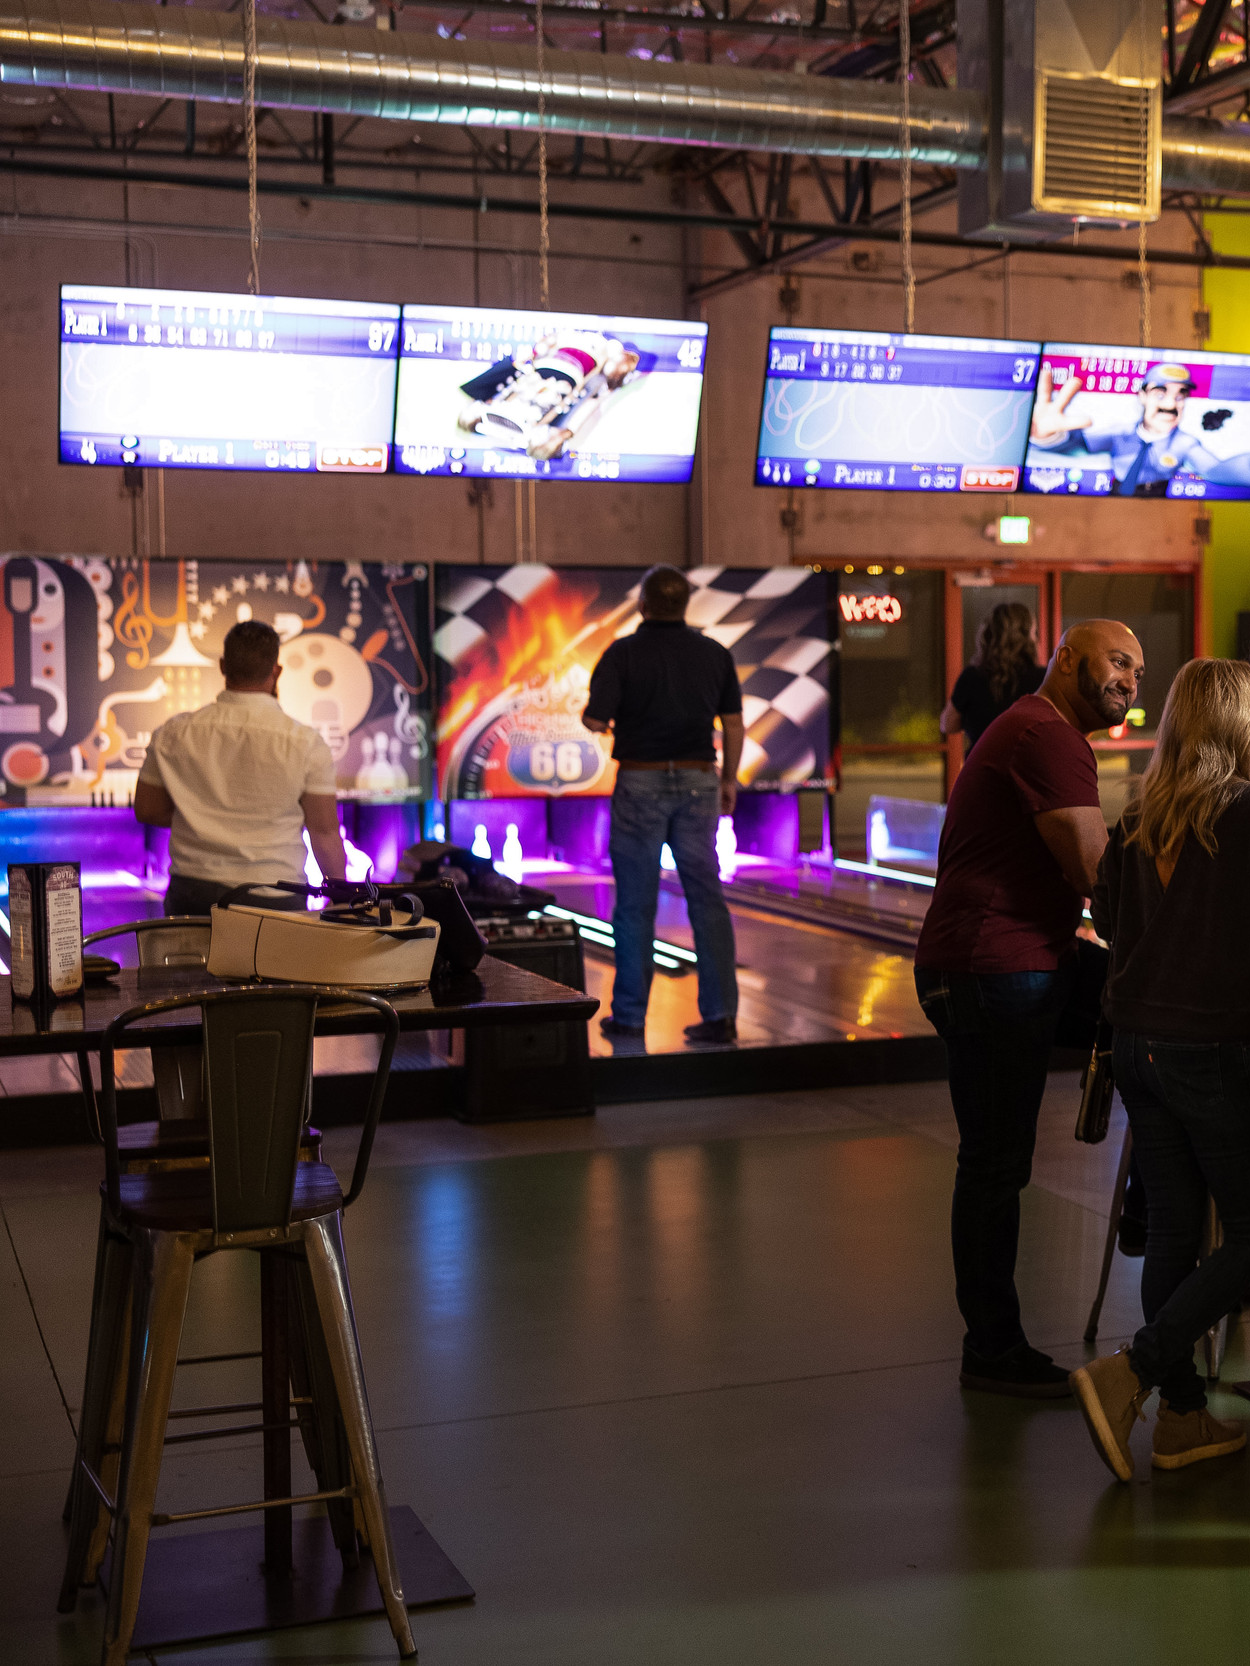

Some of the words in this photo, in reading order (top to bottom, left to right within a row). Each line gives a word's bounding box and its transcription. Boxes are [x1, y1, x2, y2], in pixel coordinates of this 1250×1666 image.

[1012, 359, 1035, 384] 37
[225, 442, 235, 465] 1
[322, 447, 382, 466] STOP
[887, 468, 895, 485] 1
[965, 471, 1013, 486] STOP
[530, 742, 583, 781] 66
